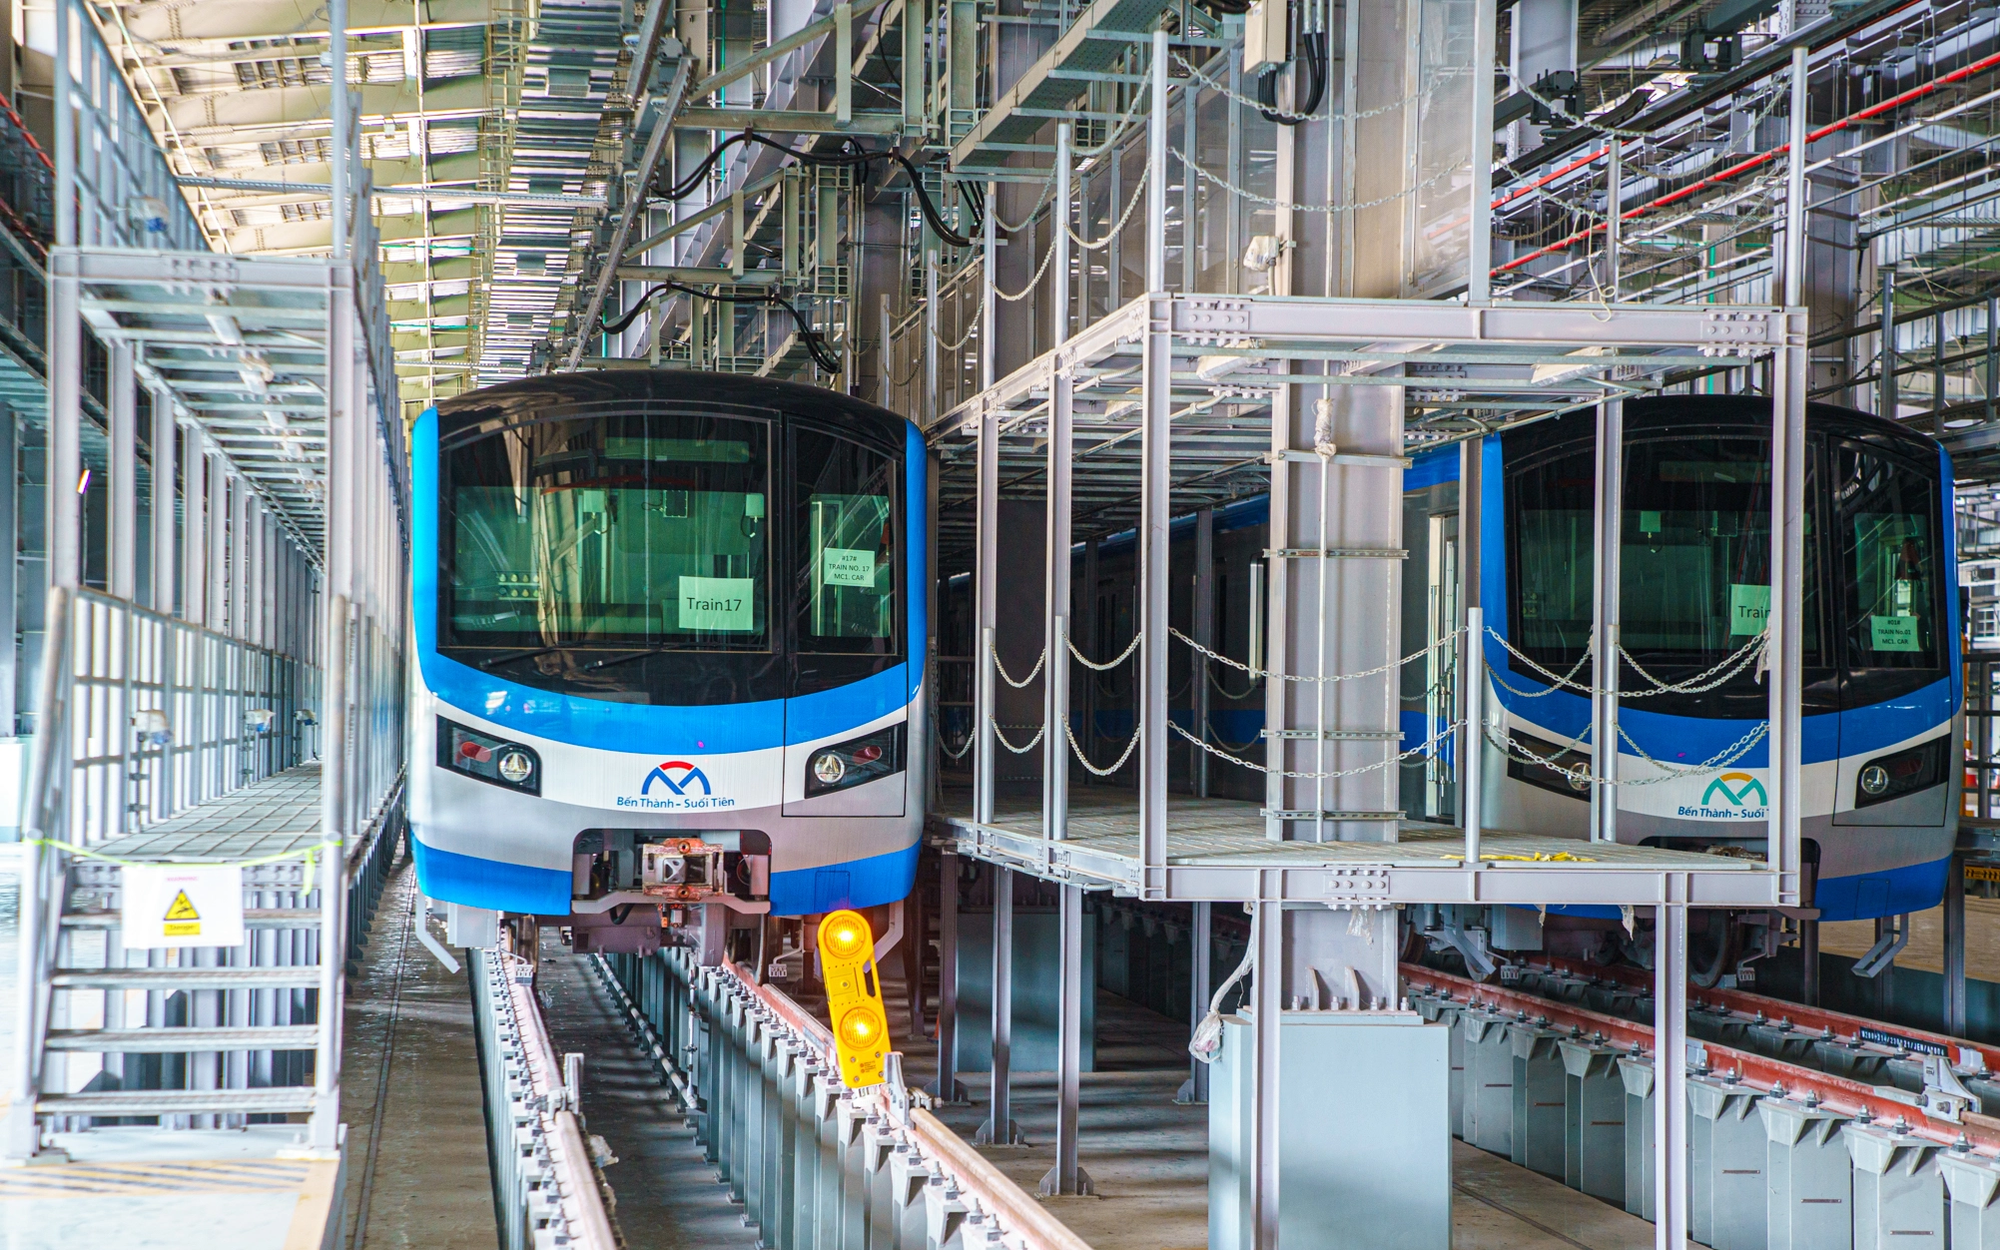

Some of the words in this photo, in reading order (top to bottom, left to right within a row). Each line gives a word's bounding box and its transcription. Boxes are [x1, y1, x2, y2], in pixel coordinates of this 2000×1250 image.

[828, 563, 848, 571] TRAIN
[848, 564, 861, 572] NO.
[686, 596, 742, 612] Train17
[616, 795, 638, 807] Bến
[639, 797, 674, 809] Thành
[684, 798, 709, 809] Suối
[711, 796, 735, 808] Tiên
[1677, 805, 1698, 817] Bến
[1700, 807, 1732, 819] Thành
[1741, 807, 1765, 819] Suối
